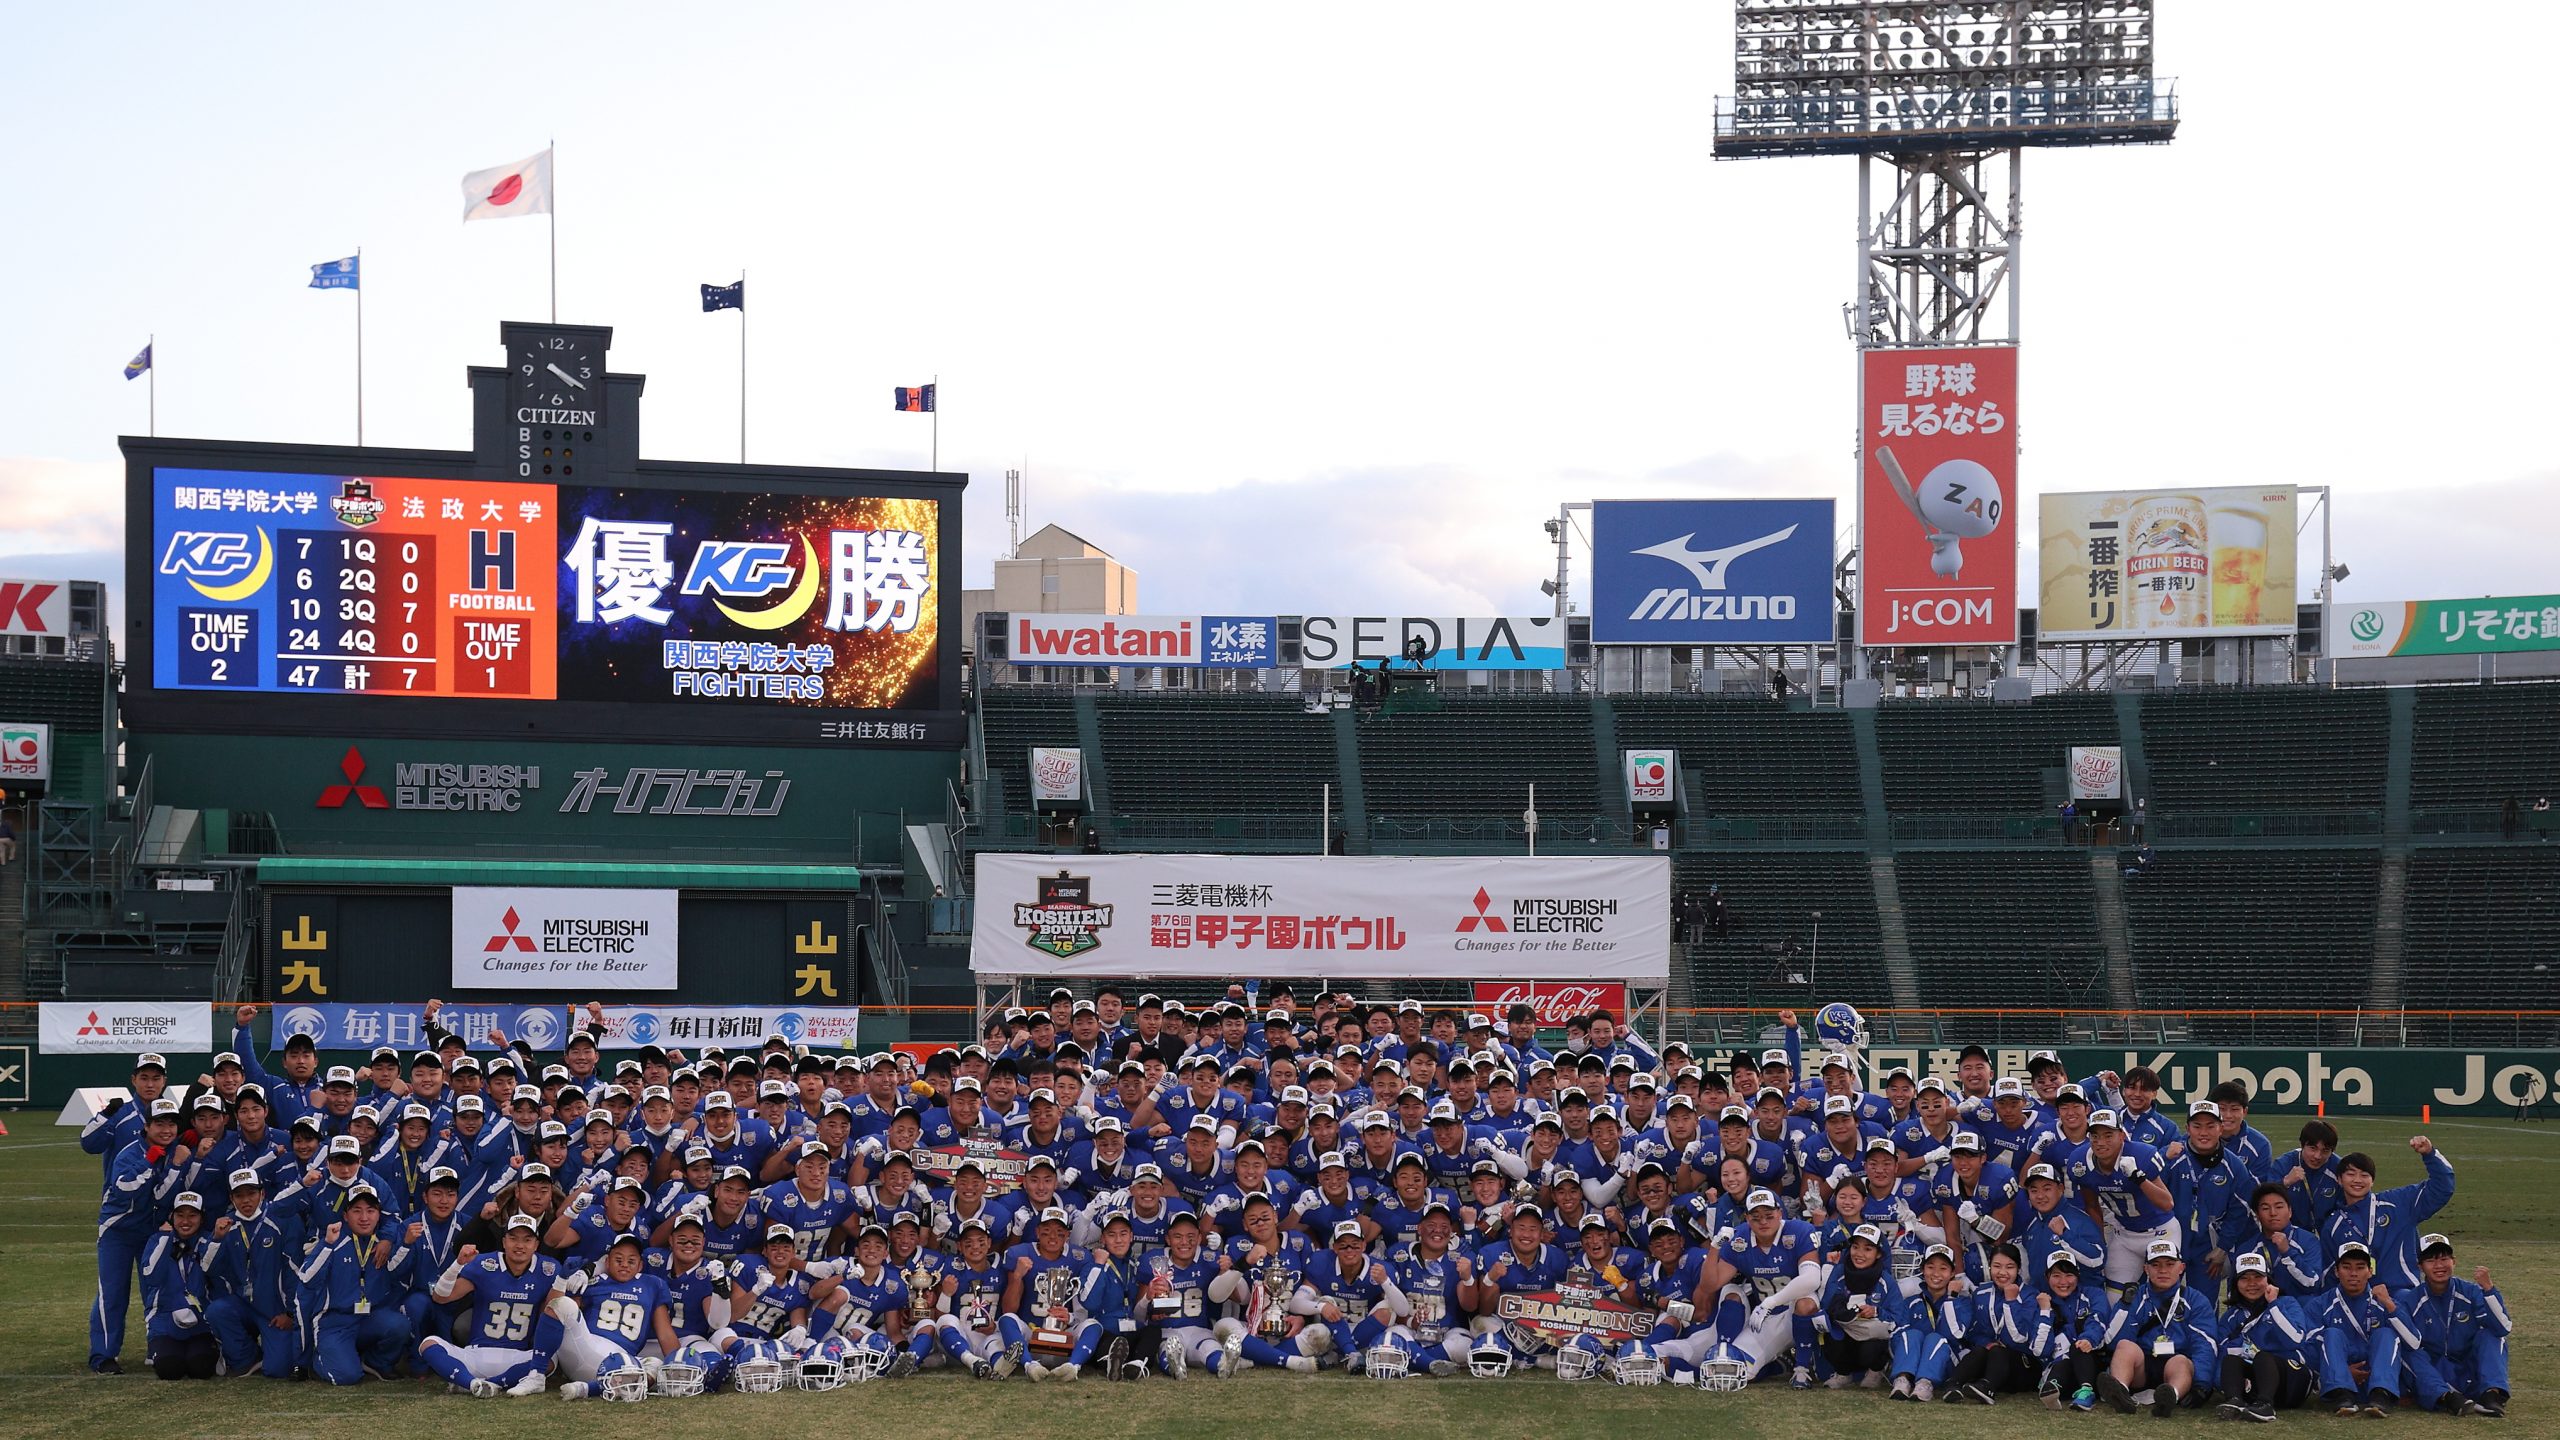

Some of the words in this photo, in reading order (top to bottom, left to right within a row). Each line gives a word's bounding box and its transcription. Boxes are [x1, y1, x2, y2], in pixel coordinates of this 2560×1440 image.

[550, 338, 564, 350] 12
[522, 364, 534, 376] 9
[580, 367, 591, 379] 3
[1905, 363, 1976, 398] 野球
[552, 394, 564, 406] 6
[518, 408, 596, 426] CITIZEN
[1878, 401, 2005, 438] 見るなら
[520, 428, 530, 442] B
[175, 487, 318, 515] 関西学院大学
[2262, 494, 2287, 502] KIRIN
[2156, 506, 2189, 518] PRIME
[298, 538, 312, 560] 7
[341, 539, 376, 564] 1Q
[402, 542, 418, 564] 0
[564, 515, 675, 626] 優
[824, 529, 930, 633] 勝
[2130, 556, 2168, 573] KIRIN
[2173, 556, 2205, 571] BEER
[296, 569, 312, 590] 6
[340, 570, 376, 594] 2Q
[402, 572, 418, 594] 0
[2088, 521, 2119, 630] 一番搾り
[2138, 576, 2196, 591] 一番搾り
[291, 599, 320, 621] 10
[340, 600, 376, 624] 3Q
[402, 603, 418, 624] 7
[449, 593, 536, 612] FOOTBALL
[189, 613, 249, 634] TIME
[1887, 598, 1993, 633] J:COM
[289, 630, 320, 651] 24
[339, 630, 376, 654] 4Q
[402, 632, 418, 654] 0
[464, 622, 520, 642] TIME
[1019, 619, 1192, 657] Iwatani
[1210, 622, 1267, 650] 水素
[190, 633, 246, 654] OUT
[466, 642, 517, 661] OUT
[662, 640, 835, 674] 関西学院大学
[1210, 651, 1267, 663] エネルギー
[210, 660, 228, 681] 2
[288, 666, 320, 687] 47
[344, 666, 370, 690] 計
[402, 668, 418, 690] 7
[486, 667, 496, 688] 1
[672, 672, 826, 700] FIGHTERS
[820, 722, 926, 740] 三井住友銀行
[2, 765, 38, 774] オークワ
[396, 762, 540, 789] MITSUBISHI
[396, 788, 521, 812] ELECTRIC
[560, 768, 792, 816] オーロラビジョン
[1634, 788, 1664, 796] オークワ
[1151, 884, 1273, 908] 三菱電機杯
[1018, 906, 1110, 925] KOSHIEN
[1513, 899, 1618, 916] MITSUBISHI
[543, 919, 649, 936] MITSUBISHI
[1040, 925, 1089, 934] BOWL
[1150, 914, 1192, 926] 第76回
[1513, 916, 1604, 933] ELECTRIC
[1150, 928, 1192, 948] 毎日
[1196, 914, 1406, 950] 甲子園ボウル
[281, 915, 327, 995] 山九
[543, 936, 636, 954] ELECTRIC
[1454, 937, 1516, 954] Changes
[1520, 939, 1542, 952] for
[1546, 939, 1568, 951] the
[1572, 938, 1617, 952] Better
[482, 957, 546, 974] Changes
[550, 958, 572, 974] for
[576, 958, 599, 972] the
[604, 958, 649, 972] Better
[795, 920, 838, 998] 山九
[112, 1016, 176, 1027] MITSUBISHI
[112, 1026, 168, 1036] ELECTRIC
[669, 1016, 764, 1039] 毎日新聞
[76, 1038, 114, 1046] Changes
[115, 1037, 130, 1046] for
[132, 1037, 146, 1045] the
[148, 1037, 176, 1045] Better
[2124, 1051, 2374, 1106] Kubota
[500, 1292, 528, 1300] FIGHTERS
[611, 1292, 638, 1300] FIGHTERS
[484, 1302, 534, 1341] 35
[596, 1300, 645, 1342] 99
[1498, 1294, 1654, 1337] CHAMPIONS
[1540, 1320, 1580, 1333] KOSHIEN
[1582, 1326, 1609, 1336] BOWL
